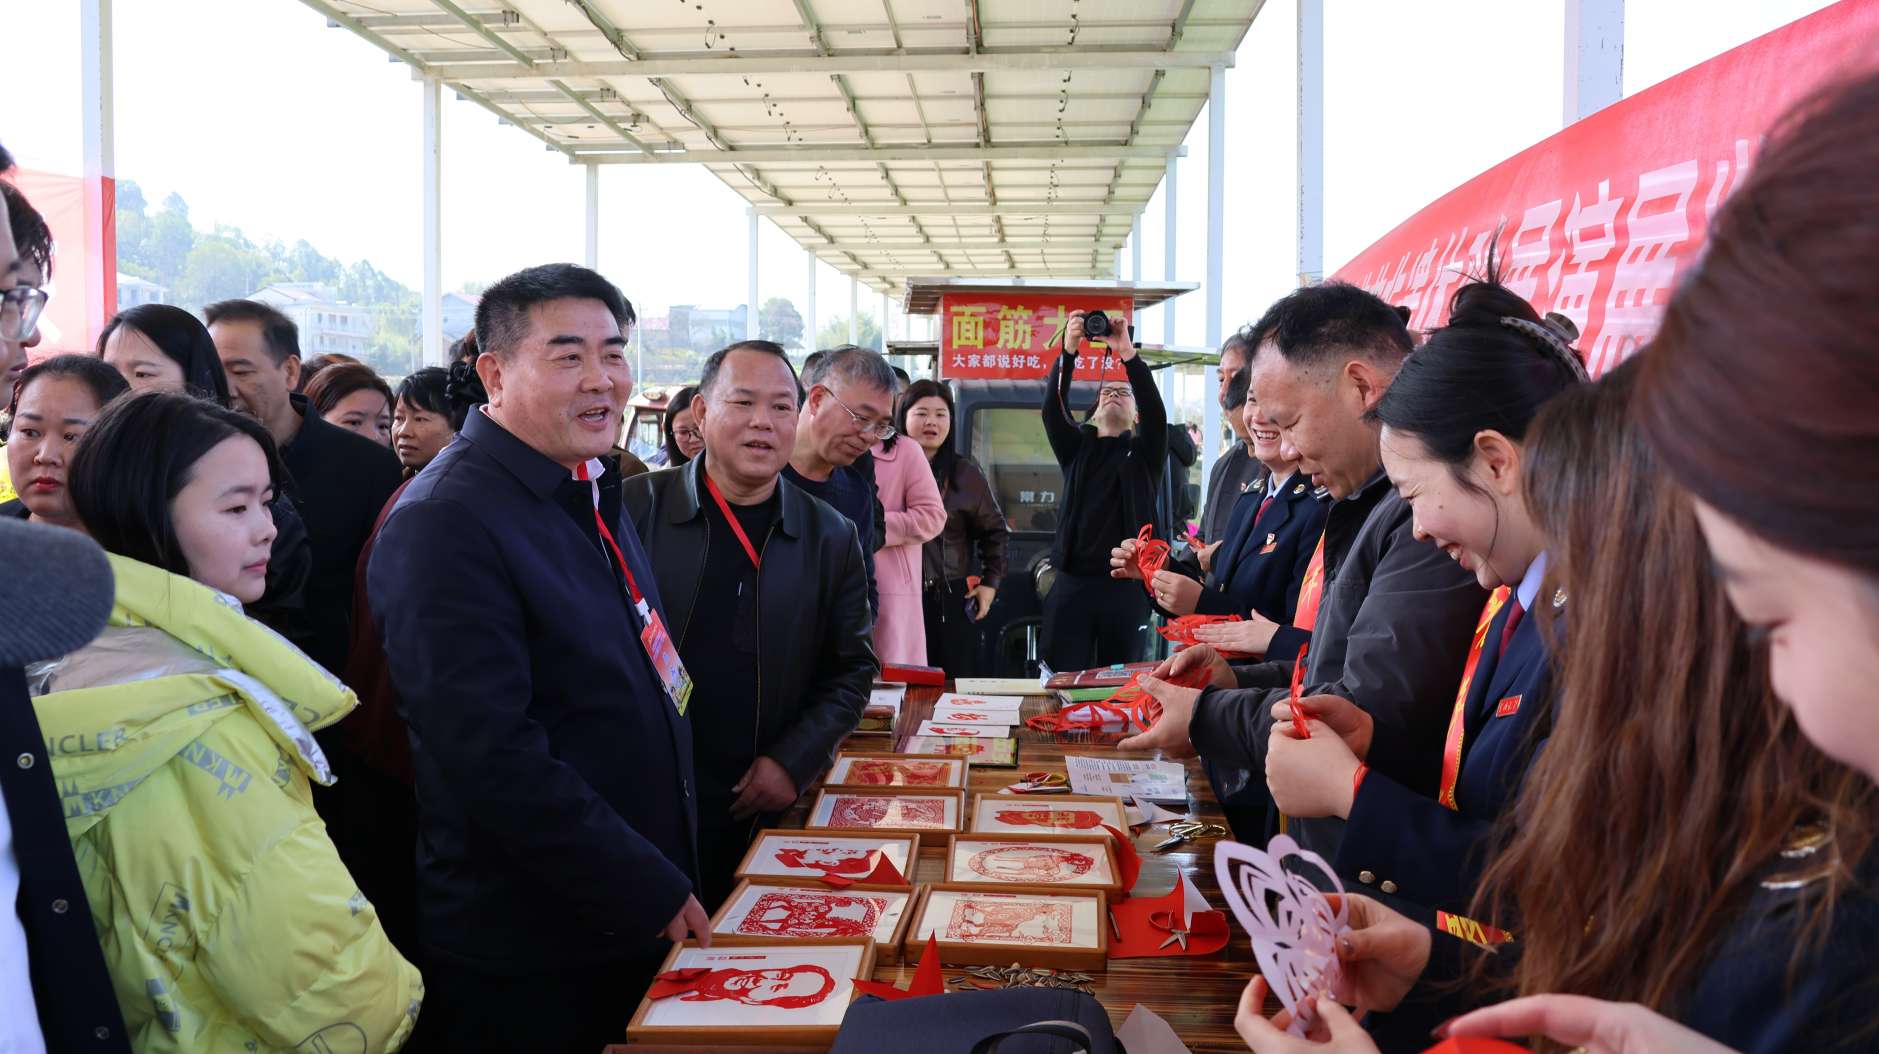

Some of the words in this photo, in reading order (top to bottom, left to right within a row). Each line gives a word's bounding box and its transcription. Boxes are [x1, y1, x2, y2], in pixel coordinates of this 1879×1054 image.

[950, 304, 1124, 350] 面筋大
[952, 353, 1122, 370] 大家都说好吃，吃了没？
